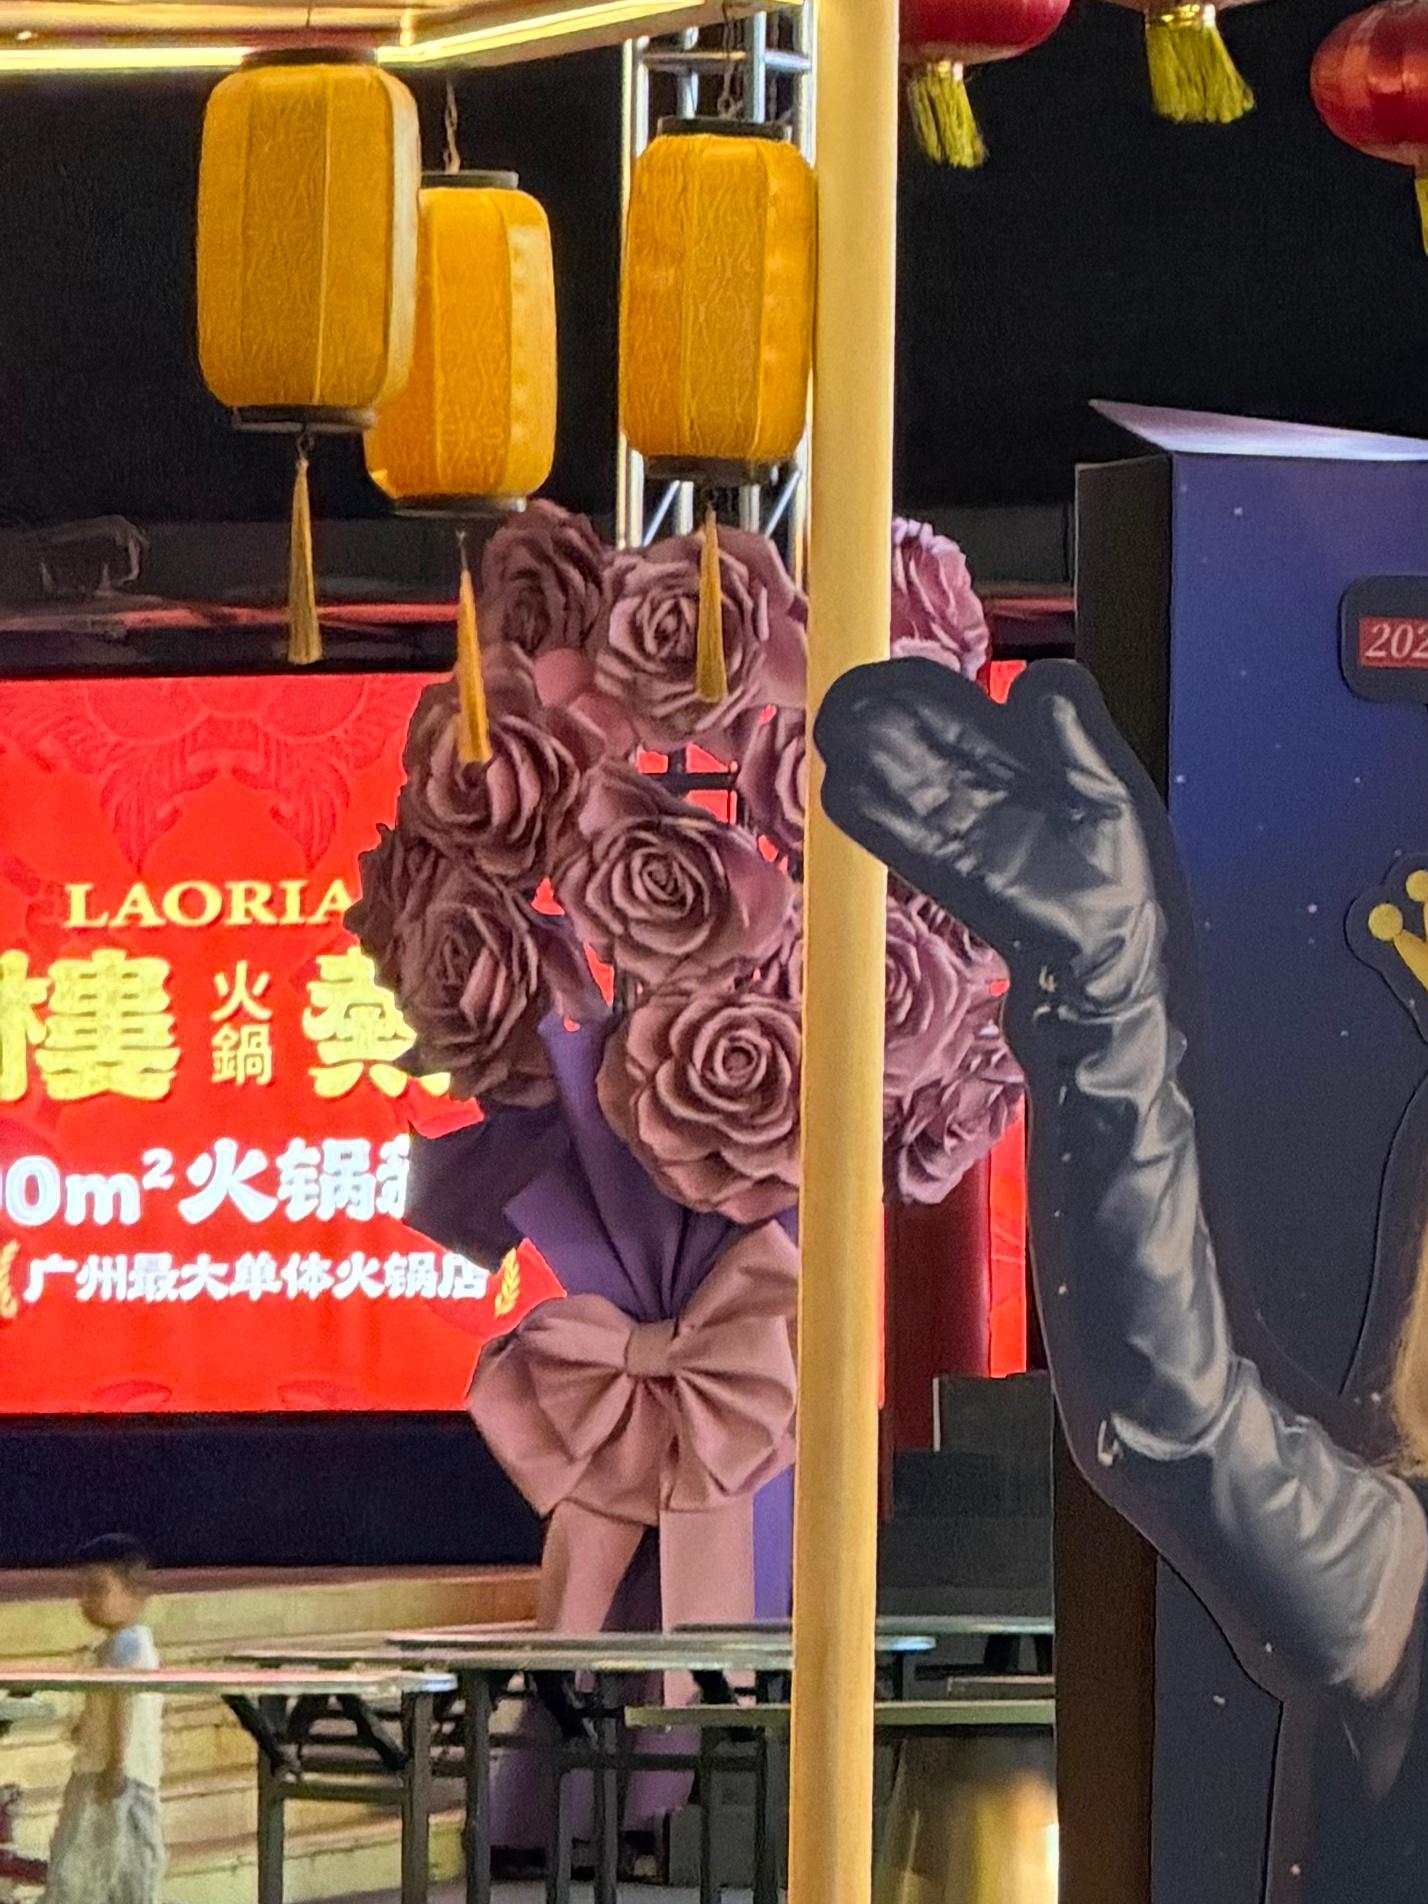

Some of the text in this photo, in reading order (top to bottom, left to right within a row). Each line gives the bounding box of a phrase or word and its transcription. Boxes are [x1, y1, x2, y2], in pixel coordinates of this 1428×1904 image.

[22, 1250, 491, 1304] 广州最大单体火锅店
